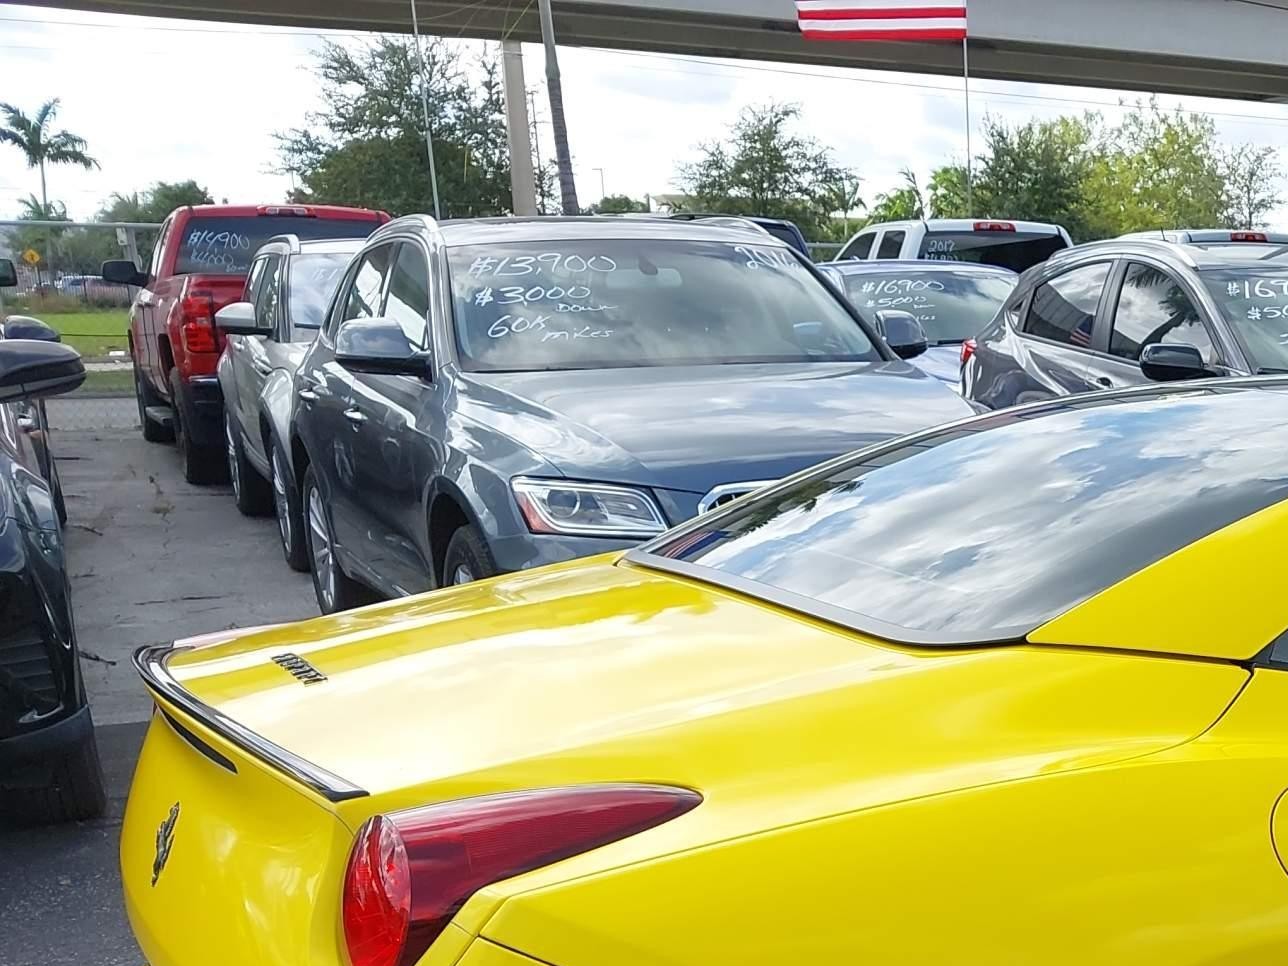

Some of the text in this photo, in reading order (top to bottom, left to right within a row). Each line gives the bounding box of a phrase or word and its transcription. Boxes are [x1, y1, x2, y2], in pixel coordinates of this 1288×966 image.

[468, 252, 617, 279] $13,900
[474, 285, 592, 307] $3,000
[861, 279, 945, 295] $16,900
[865, 295, 928, 308] $5,000
[487, 314, 552, 339] 60K
